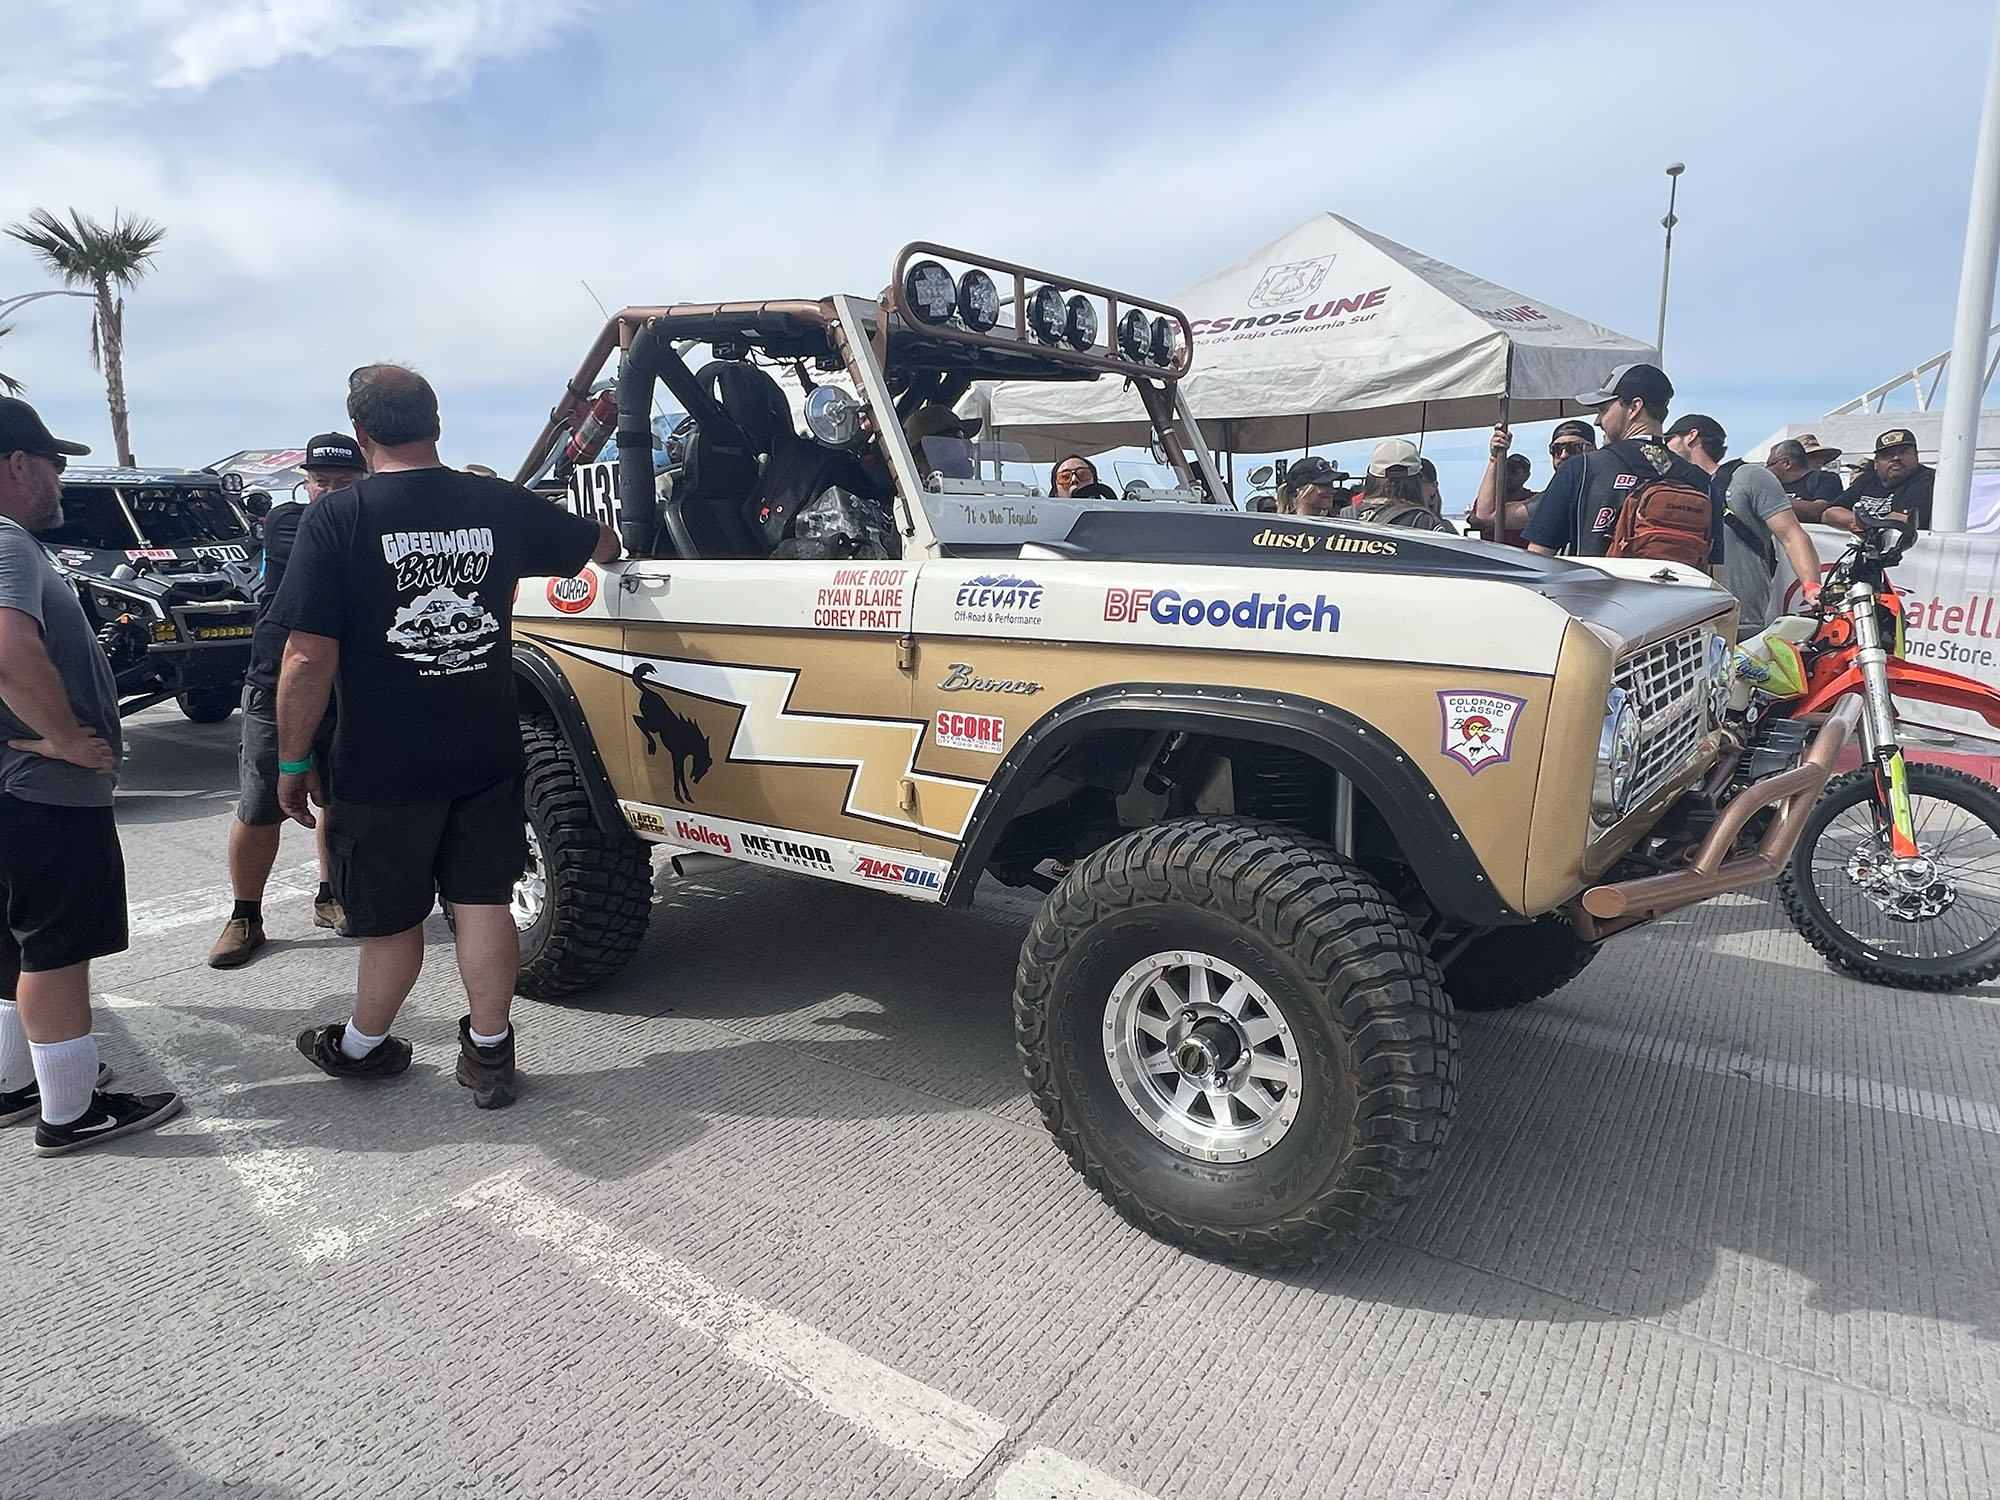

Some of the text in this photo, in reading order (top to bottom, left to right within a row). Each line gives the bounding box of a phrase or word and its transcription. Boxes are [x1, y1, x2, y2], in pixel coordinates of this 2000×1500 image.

[1233, 331, 1266, 342] Baja
[1271, 320, 1345, 338] California
[1349, 312, 1378, 325] Sur
[313, 446, 353, 455] METHOD
[1617, 476, 1636, 485] BF
[381, 527, 495, 565] GREENWOOD
[1252, 528, 1321, 553] dusty
[127, 549, 174, 560] SCORE
[394, 550, 490, 591] BRONCO
[833, 569, 908, 586] MIKE ROOT
[817, 588, 903, 608] RYAN BLAIRE
[955, 588, 1044, 611] ELEVATE
[814, 609, 902, 628] COREY PRATT
[954, 611, 1042, 626] Off-Road & Performance
[1103, 587, 1341, 633] BFGoodrich
[1896, 590, 2000, 640] atell
[937, 662, 1045, 695] Bronco
[1449, 698, 1511, 711] COLORADO
[1455, 705, 1505, 717] CLASSIC
[938, 713, 1003, 743] SCORE
[1449, 718, 1506, 734] Broncos
[938, 734, 1002, 748] INTERNATIONAL
[952, 740, 972, 748] ROAD
[974, 743, 1002, 752] RACING
[675, 820, 732, 853] Holley
[740, 832, 832, 864] METHOD
[745, 848, 835, 873] RACE WHEELS
[855, 856, 939, 889] AMSOIL
